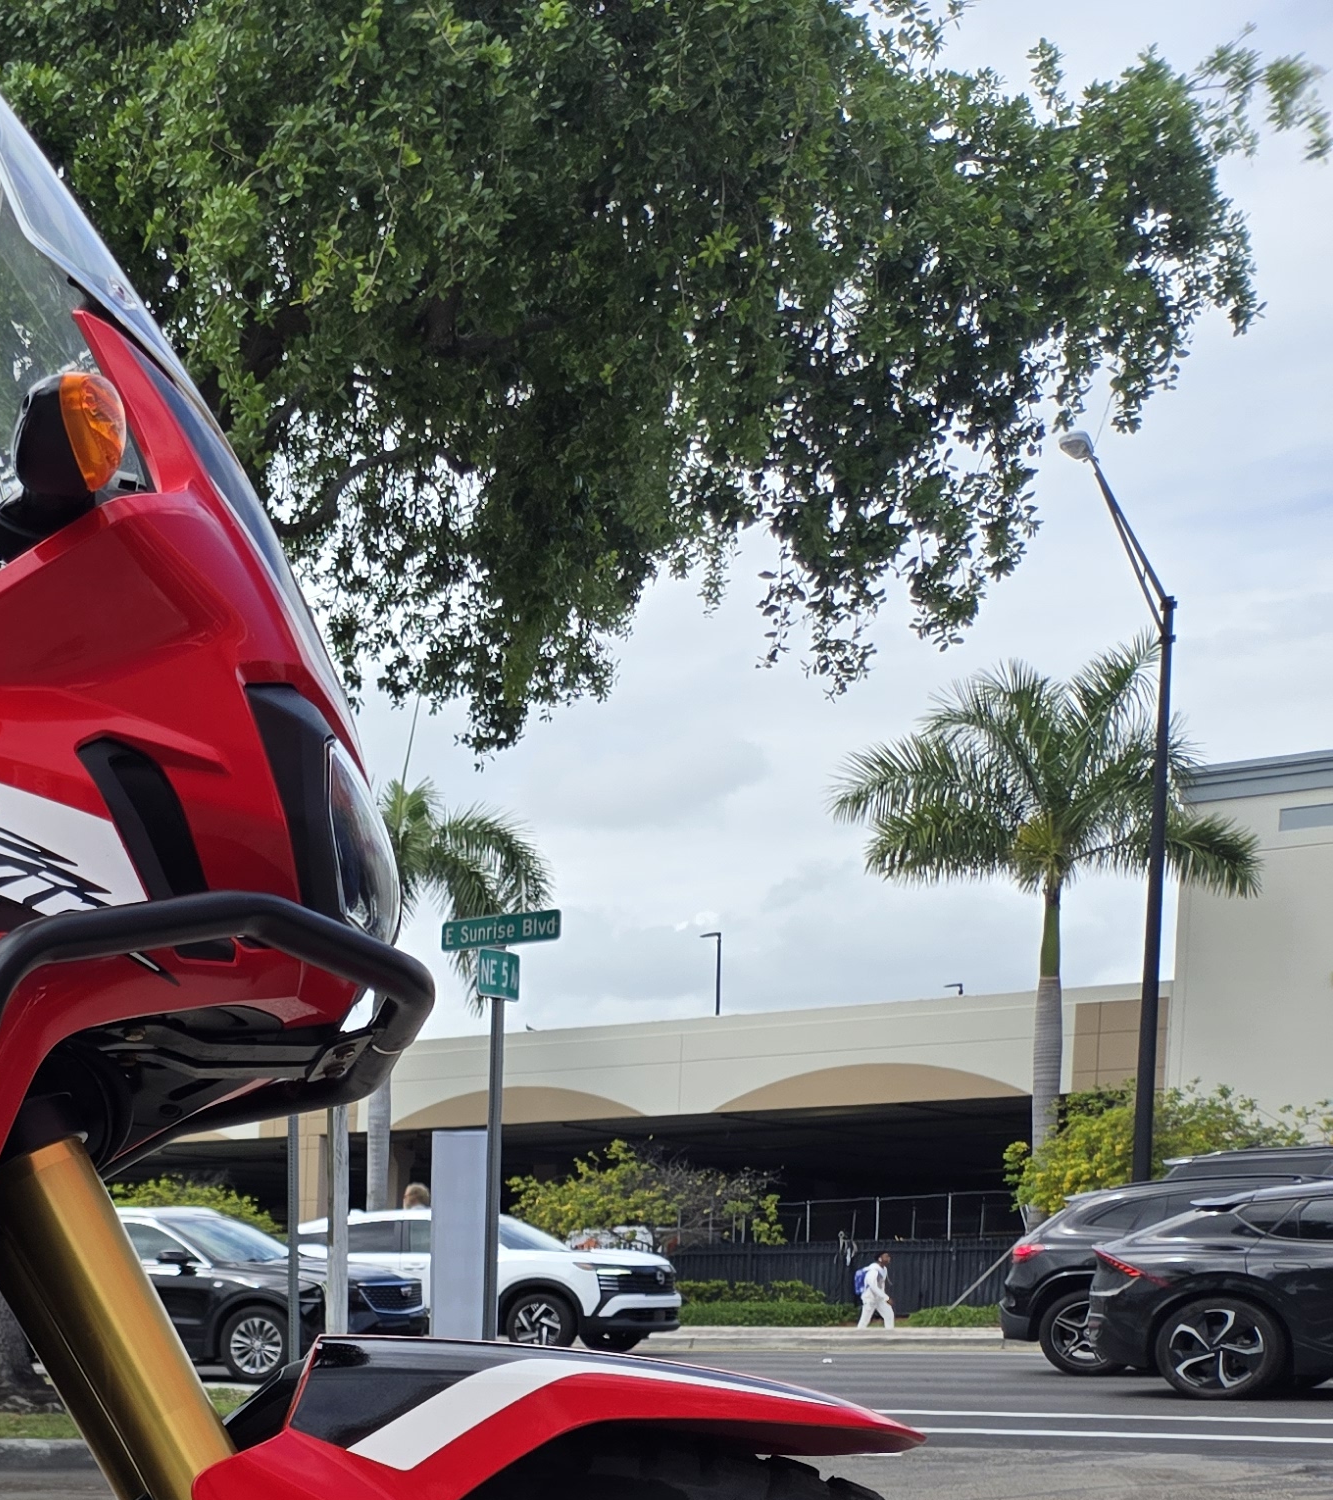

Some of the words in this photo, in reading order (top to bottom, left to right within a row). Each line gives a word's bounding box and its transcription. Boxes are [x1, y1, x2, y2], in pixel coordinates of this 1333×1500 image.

[445, 927, 454, 946] E
[460, 922, 515, 944] Sunrise
[522, 916, 556, 937] Blvd
[481, 958, 497, 986] NE
[501, 961, 509, 988] 5
